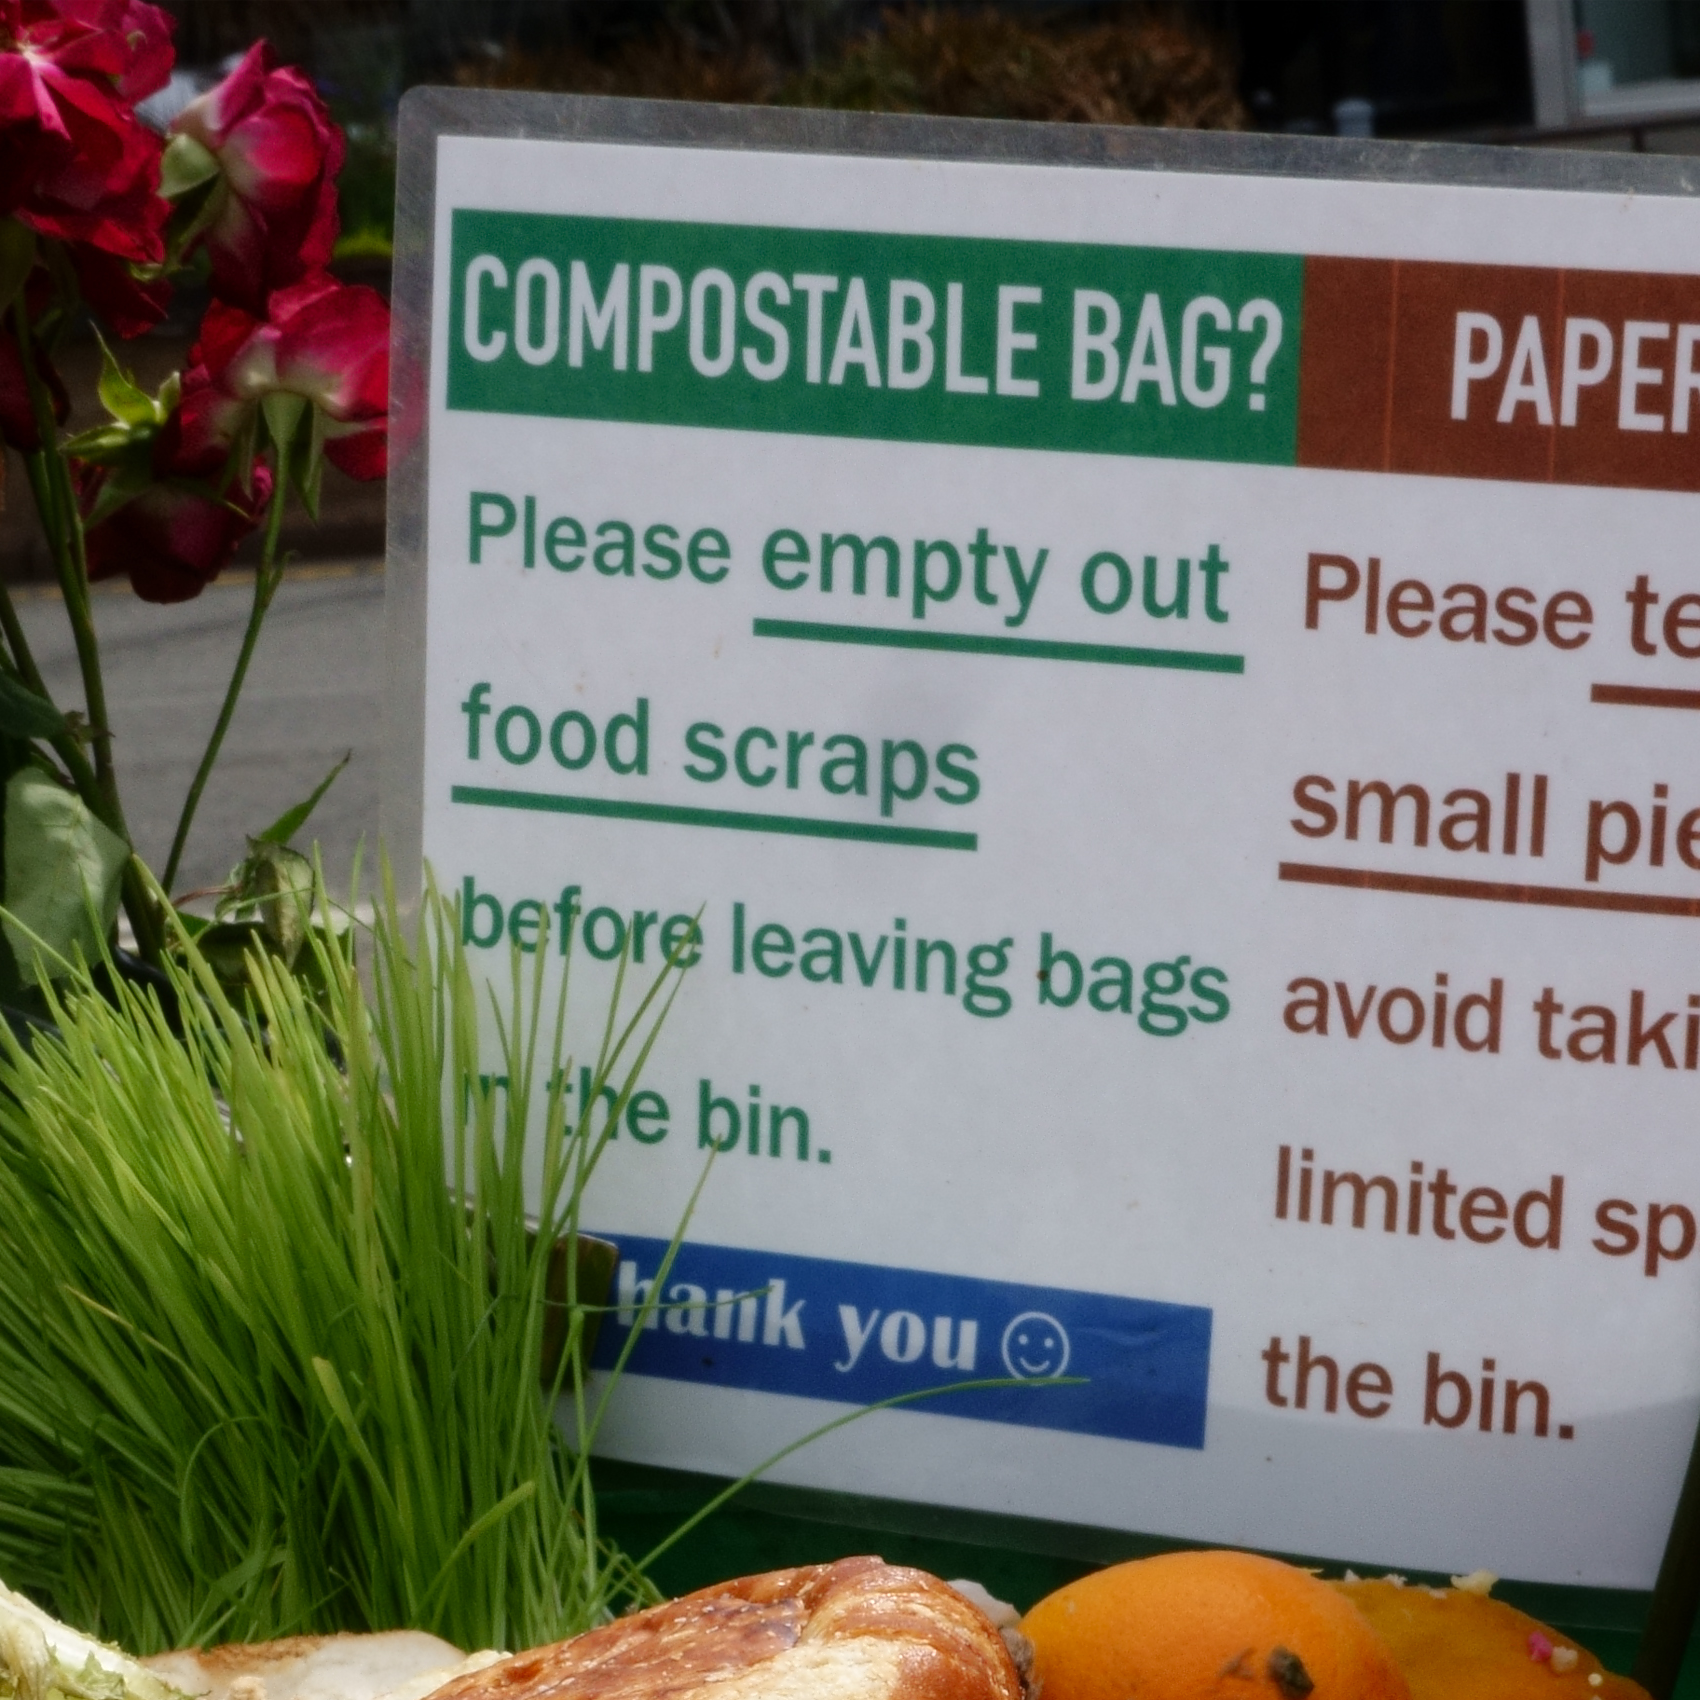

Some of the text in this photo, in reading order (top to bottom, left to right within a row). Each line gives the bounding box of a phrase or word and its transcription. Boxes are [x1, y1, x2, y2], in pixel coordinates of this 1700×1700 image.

[463, 253, 1283, 411] COMPOSTABLE BAG?
[469, 492, 1229, 626] Please empty out
[1305, 553, 1593, 650] Please
[462, 682, 980, 816] food scraps
[1292, 772, 1548, 857] small
[461, 876, 1230, 1036] before leaving bags
[1282, 973, 1504, 1052] avoid
[698, 1079, 831, 1164] bin.
[1276, 1146, 1563, 1250] limited
[617, 1259, 978, 1371] hank you
[1263, 1337, 1575, 1440] the bin.
